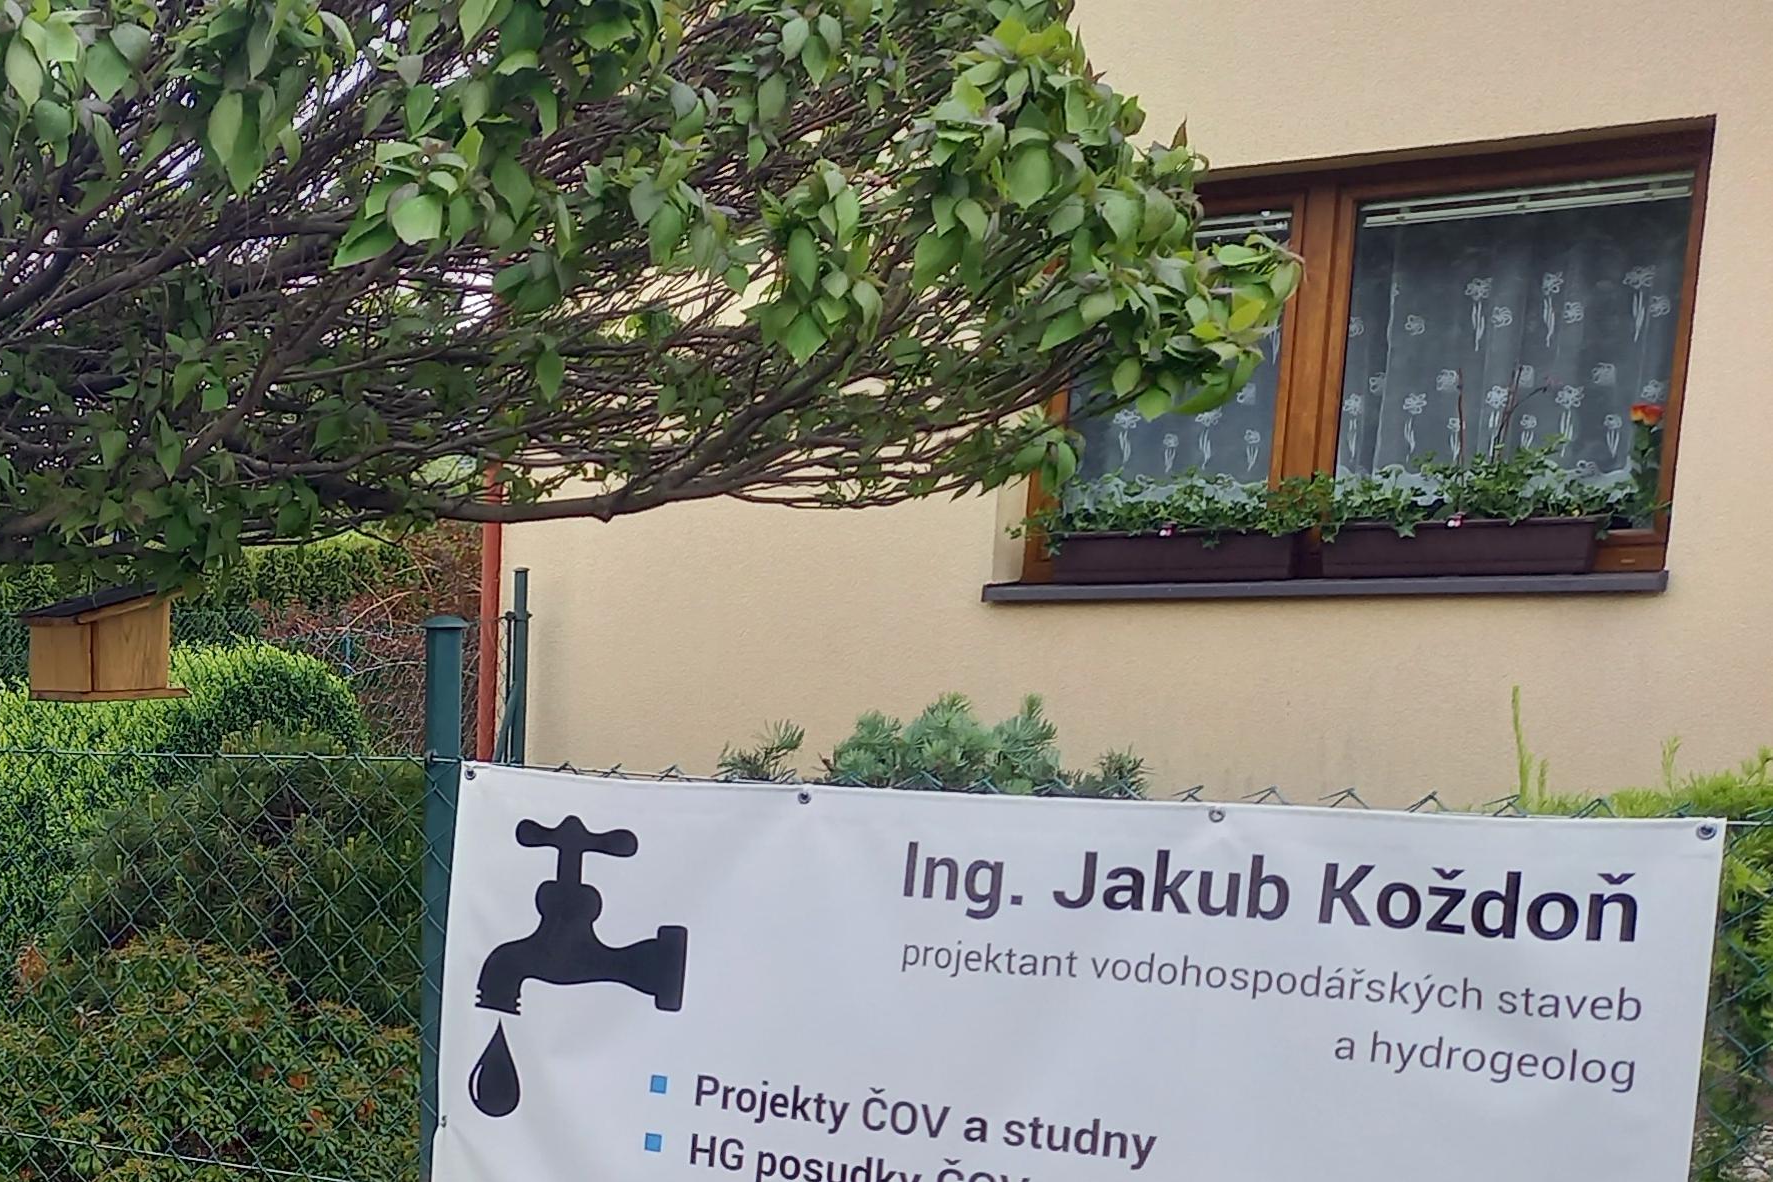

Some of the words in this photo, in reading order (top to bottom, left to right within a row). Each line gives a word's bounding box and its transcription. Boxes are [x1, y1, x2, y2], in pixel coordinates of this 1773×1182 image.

[902, 841, 1023, 919] Ing.
[1052, 850, 1290, 922] Jakub
[1318, 861, 1638, 943] Koždoň
[901, 938, 1078, 979] projektant
[1091, 952, 1485, 1014] vodohospodářských
[1497, 987, 1642, 1022] staveb
[1334, 1034, 1355, 1061] a
[1371, 1030, 1636, 1092] hydrogeolog
[689, 1133, 745, 1171] HG
[695, 1074, 850, 1134] Projekty
[862, 1088, 951, 1139] ČOV
[963, 1115, 988, 1143] a
[1002, 1115, 1157, 1170] studny
